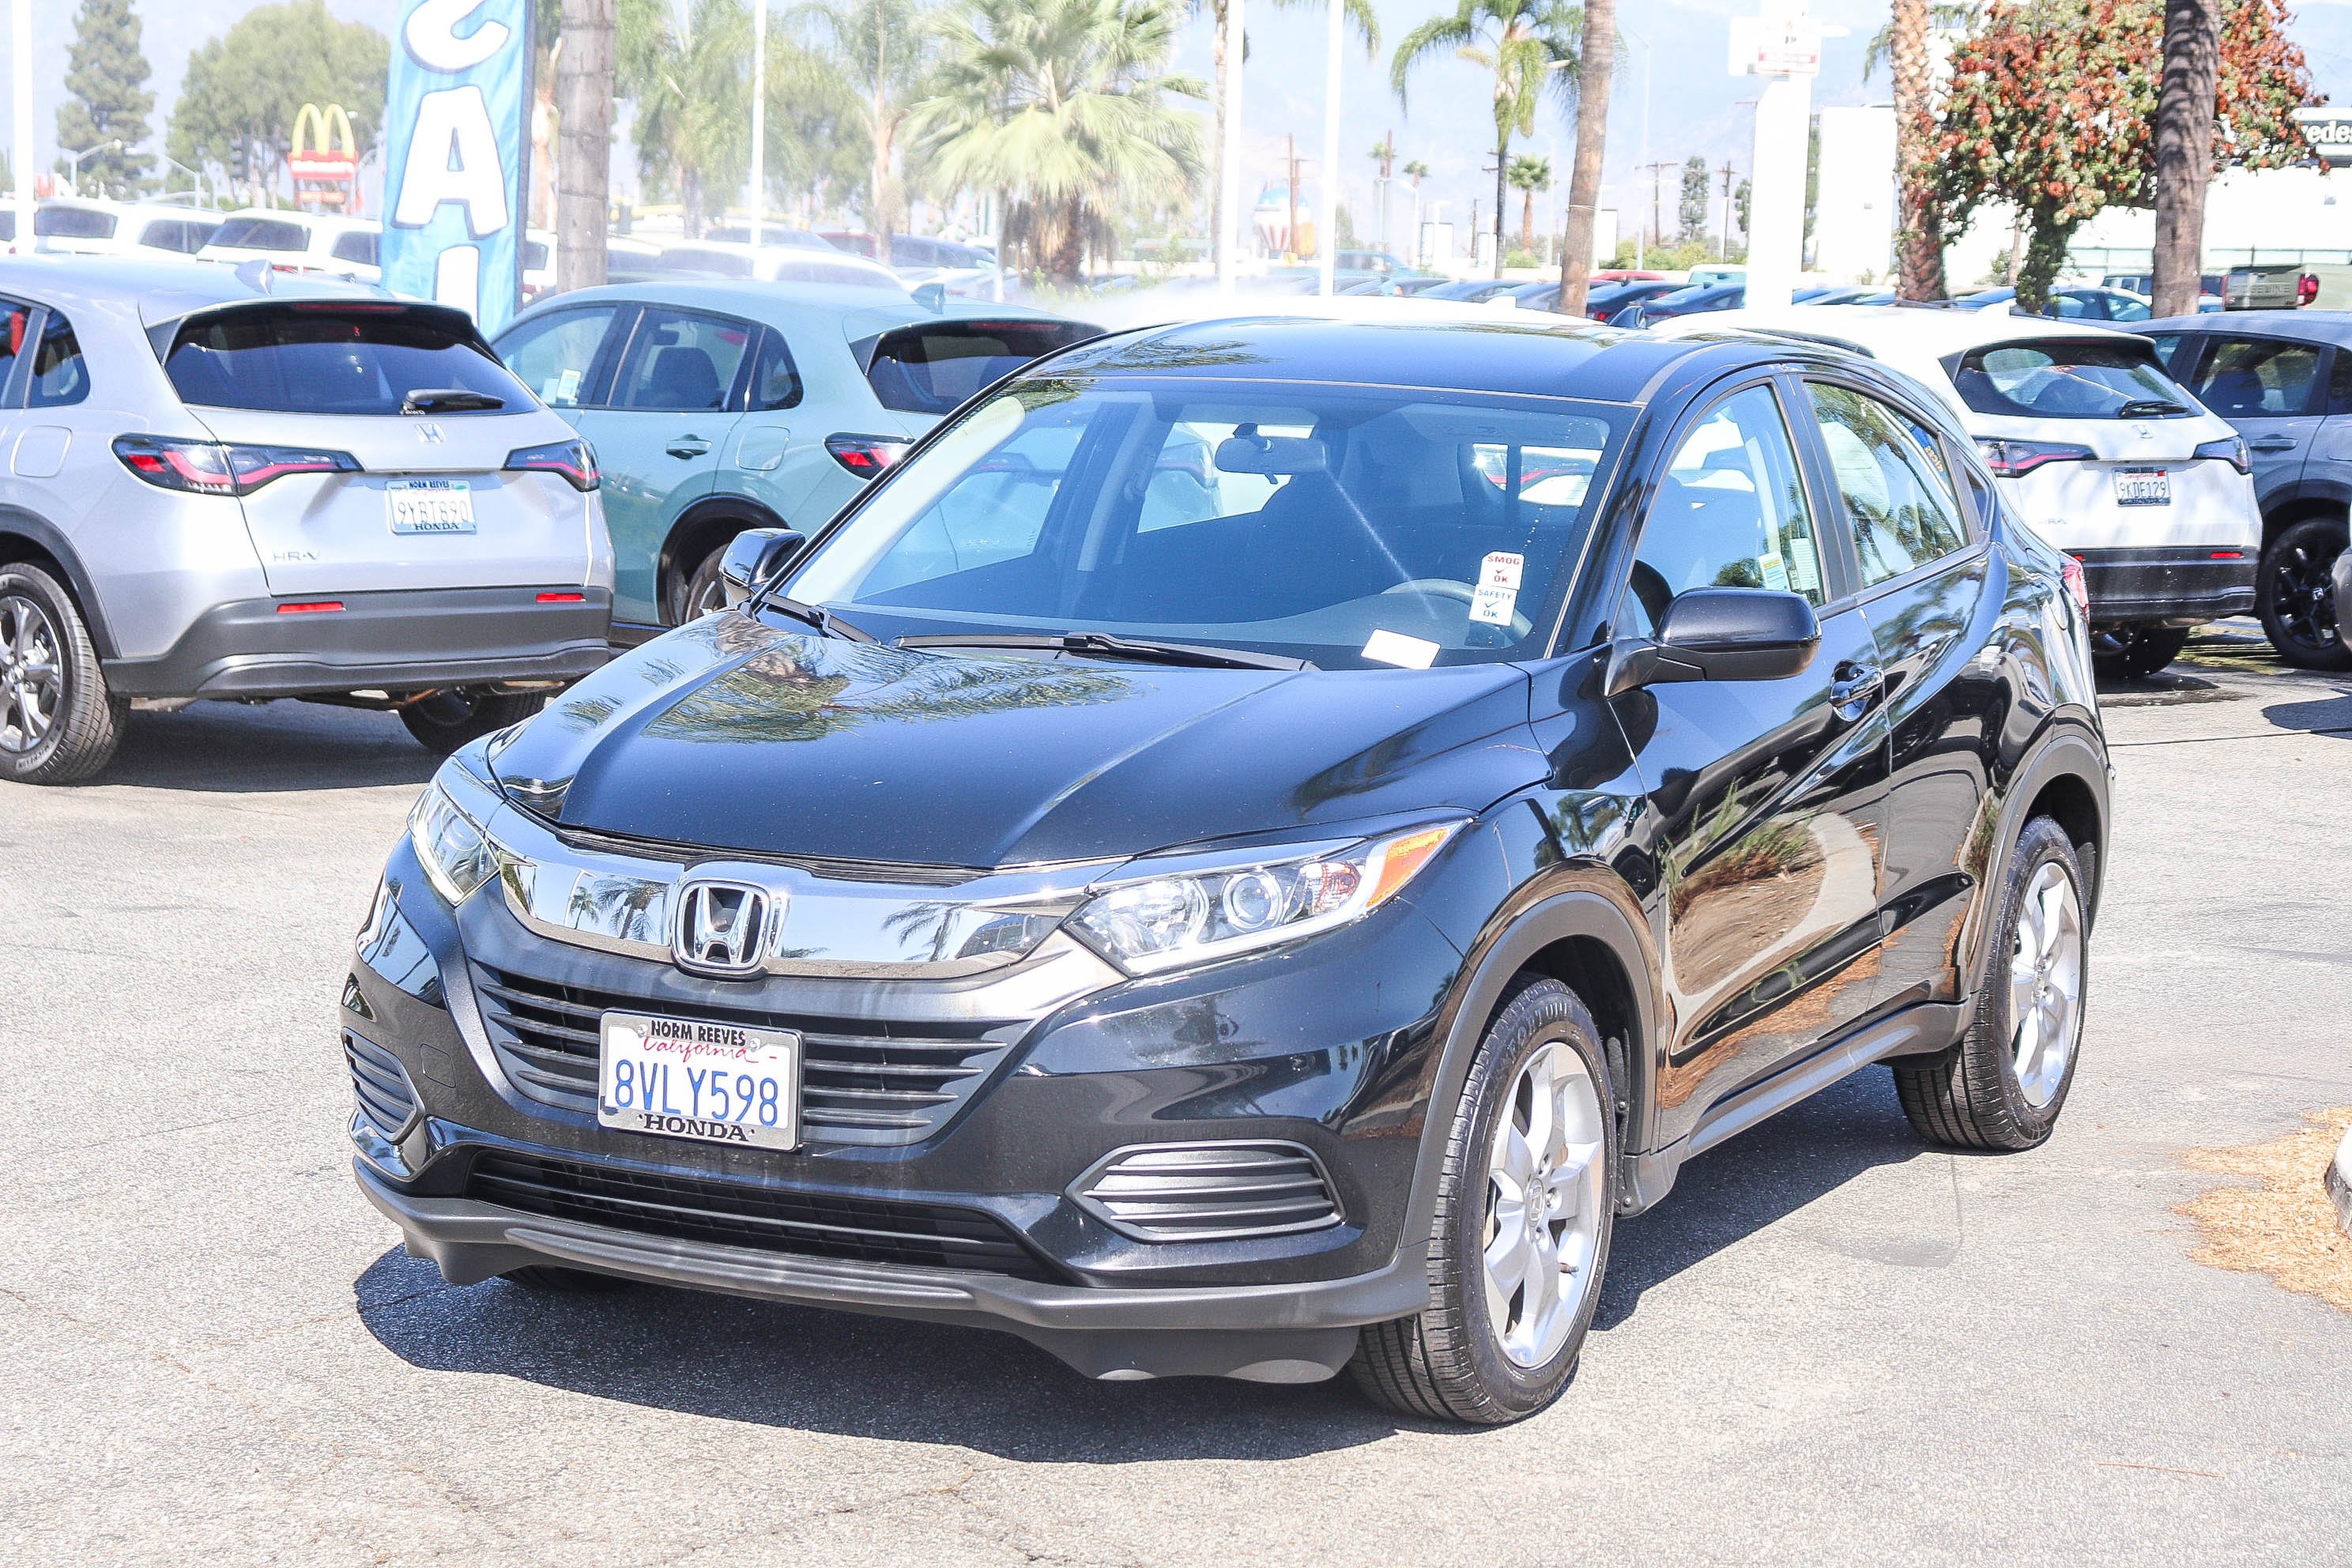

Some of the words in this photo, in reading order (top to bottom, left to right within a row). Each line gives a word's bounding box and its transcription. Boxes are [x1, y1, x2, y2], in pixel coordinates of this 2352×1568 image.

[1487, 555, 1520, 565] SMOG
[1478, 589, 1512, 601] SAFETY
[1483, 609, 1498, 618] OK
[651, 1020, 693, 1040] NORM
[698, 1025, 746, 1047] REEVES
[643, 1036, 760, 1064] California
[615, 1058, 778, 1127] 8VLY598
[643, 1113, 750, 1143] HONDA
